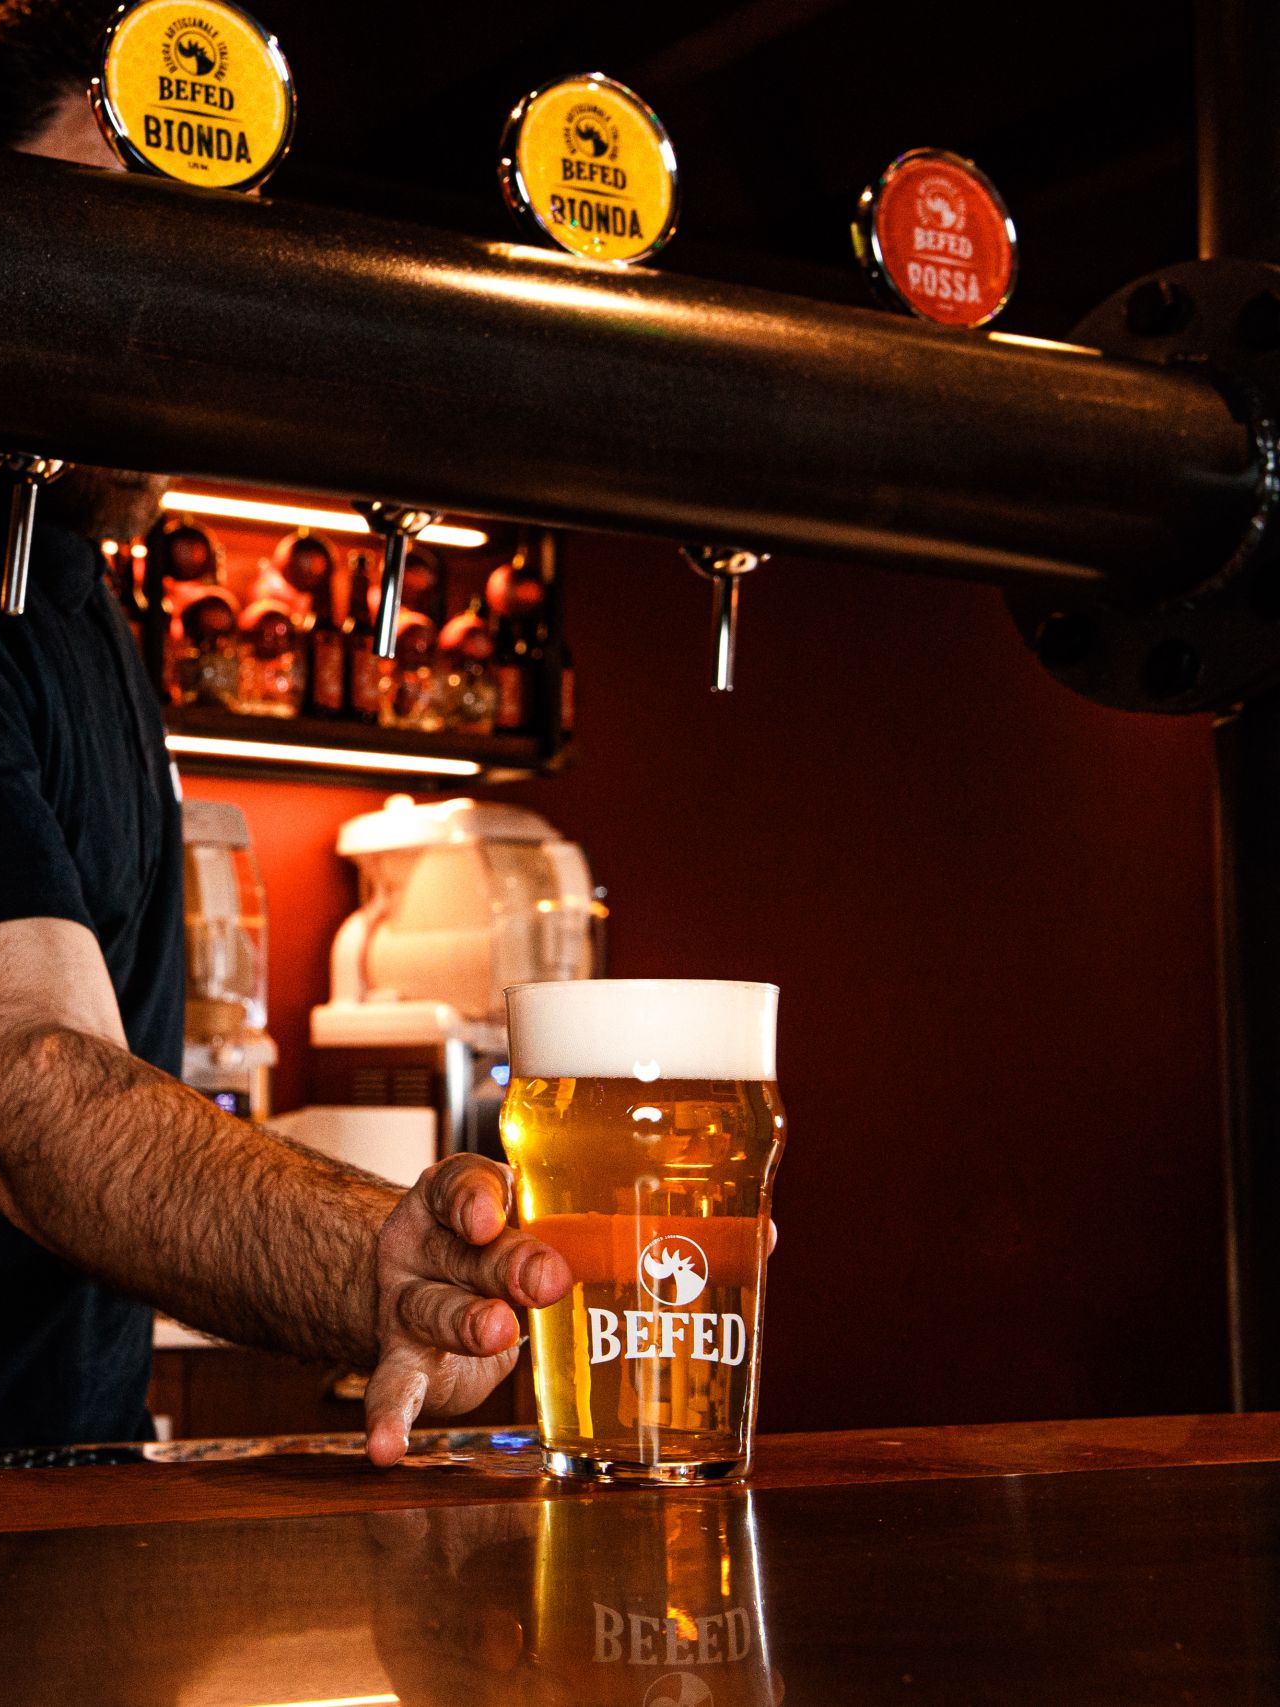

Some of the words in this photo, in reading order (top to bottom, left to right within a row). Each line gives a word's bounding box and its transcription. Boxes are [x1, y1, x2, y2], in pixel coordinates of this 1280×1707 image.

[158, 76, 235, 111] BEFED
[144, 115, 252, 164] BIONDA
[561, 158, 627, 190] BEFED
[550, 194, 644, 240] BIONDA
[914, 227, 974, 259] BEFED
[907, 262, 982, 304] ROSSA
[588, 1307, 746, 1366] BEFED
